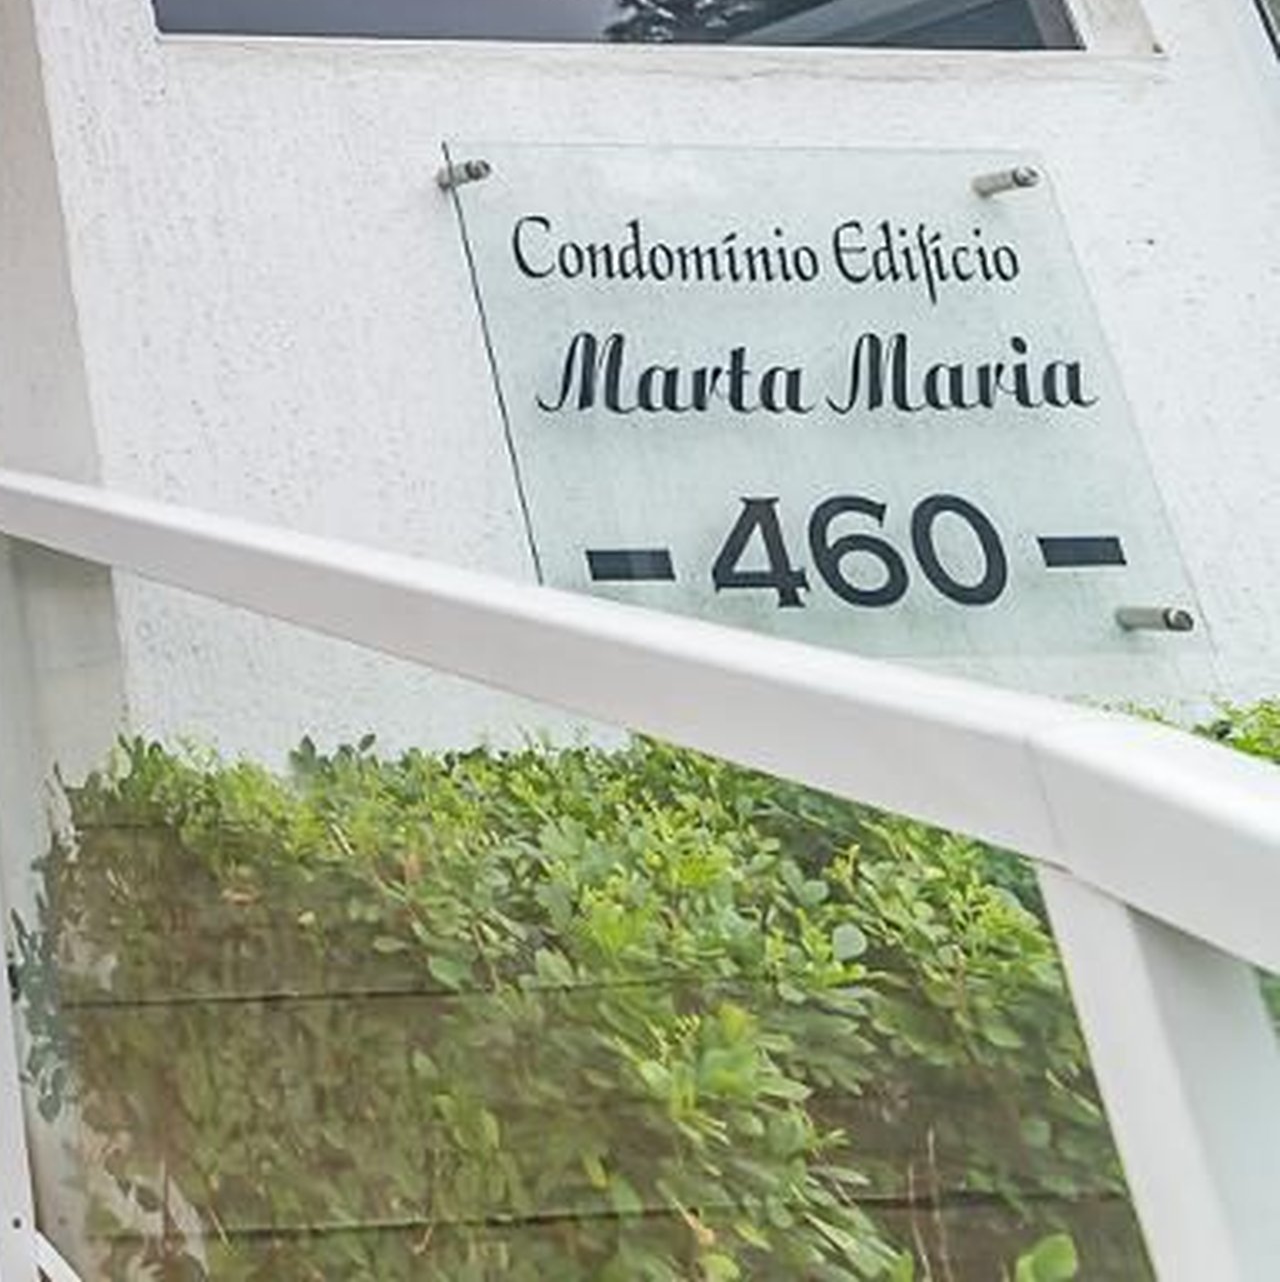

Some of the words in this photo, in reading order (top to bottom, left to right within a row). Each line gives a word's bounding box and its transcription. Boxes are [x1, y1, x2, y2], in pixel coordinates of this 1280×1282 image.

[511, 215, 820, 283] Condomínio
[832, 219, 1021, 306] Edifício
[534, 332, 814, 416] Marta
[825, 332, 1099, 416] Maria
